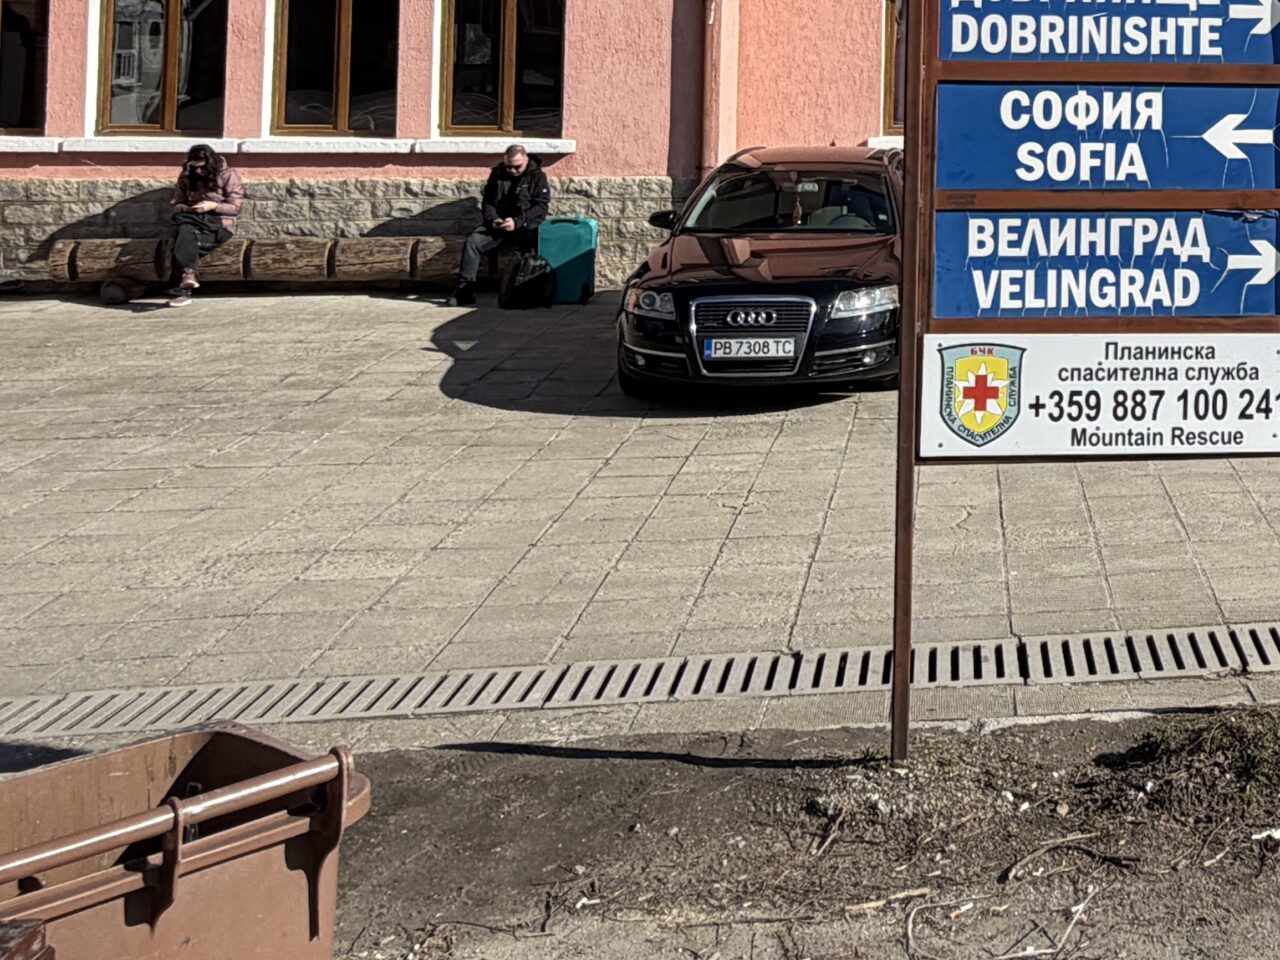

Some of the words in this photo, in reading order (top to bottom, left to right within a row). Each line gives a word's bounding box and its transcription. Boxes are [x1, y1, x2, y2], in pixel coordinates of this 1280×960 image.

[952, 14, 1223, 56] DOBRINISHTE
[1000, 89, 1163, 131] СОФИЯ
[1016, 141, 1148, 182] SOFIA
[967, 217, 1211, 263] ВЕЛИНГРАД
[972, 268, 1200, 309] VELINGRAD
[713, 341, 732, 355] PB
[735, 340, 770, 355] 7308
[773, 340, 792, 355] TC
[970, 347, 995, 356] БЧК
[1104, 341, 1216, 361] Планинска
[1058, 366, 1178, 382] спасителна
[1185, 361, 1259, 386] служба
[1028, 389, 1101, 422] +359
[1112, 389, 1165, 422] 887
[1177, 388, 1228, 421] 100
[1070, 427, 1164, 447] Mountain
[1170, 426, 1244, 446] Rescue
